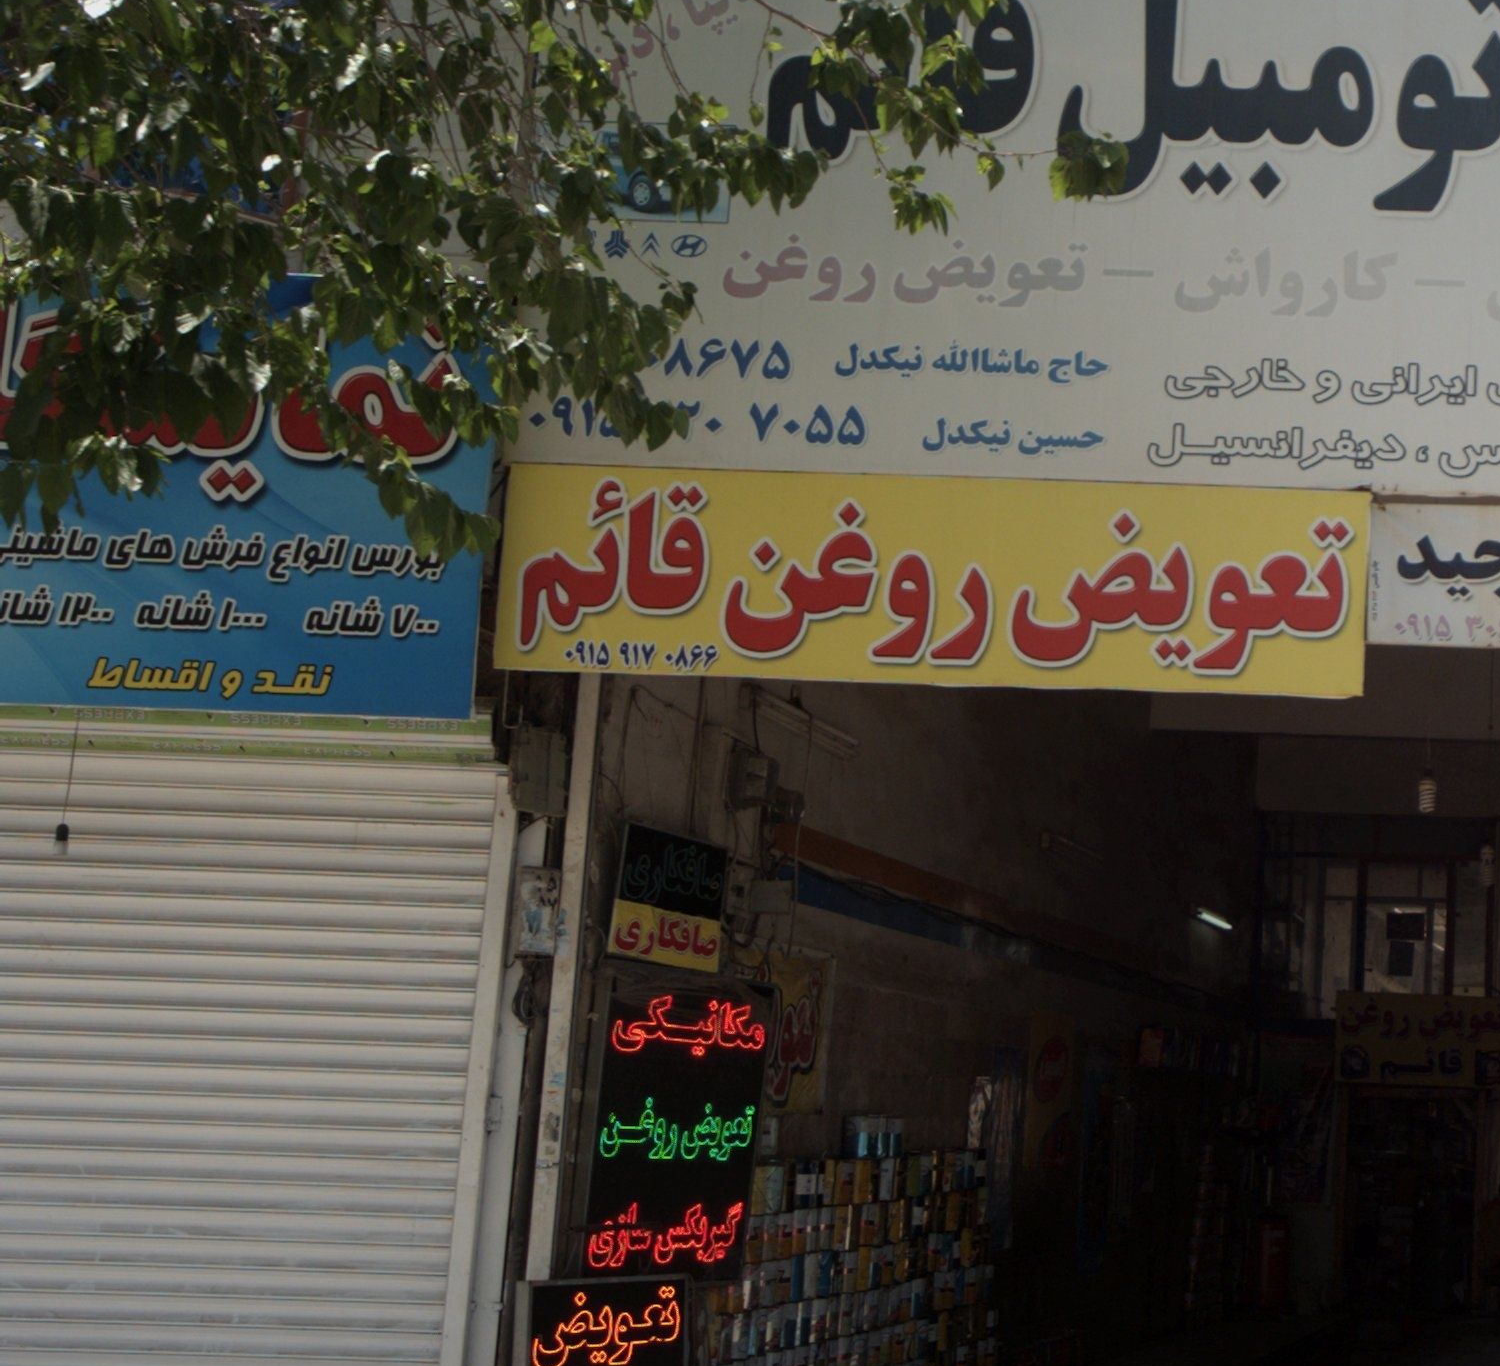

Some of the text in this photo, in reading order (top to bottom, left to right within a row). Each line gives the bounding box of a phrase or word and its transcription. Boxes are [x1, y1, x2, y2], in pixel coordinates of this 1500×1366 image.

[722, 234, 874, 303] روغن
[893, 243, 1087, 307] تعویض
[1174, 248, 1398, 317] کارواش
[834, 342, 923, 378] نیکدل
[1047, 347, 1109, 385] حاج
[1165, 358, 1305, 399] خارجی
[1315, 369, 1341, 404] و
[1352, 363, 1478, 406] ایرانی
[750, 402, 866, 445] ۷۰۵۵
[922, 415, 1011, 452] نیکدل
[1018, 419, 1104, 456] حسین
[1147, 424, 1406, 469] دیفرانسیل
[104, 531, 175, 571] های
[181, 526, 264, 569] فرش
[267, 533, 348, 581] انواع
[520, 477, 1353, 670] تعویض روغن قائم
[135, 591, 214, 630] شانه
[304, 596, 385, 636] شانه
[564, 642, 719, 672] ۰۹۱۵ ۹۱۷ ۰۸۶۶
[87, 657, 334, 699] نقد و اقساط
[614, 916, 717, 957] صافکاری
[1340, 998, 1410, 1036] روغن
[599, 1096, 756, 1161] تعویض روغن
